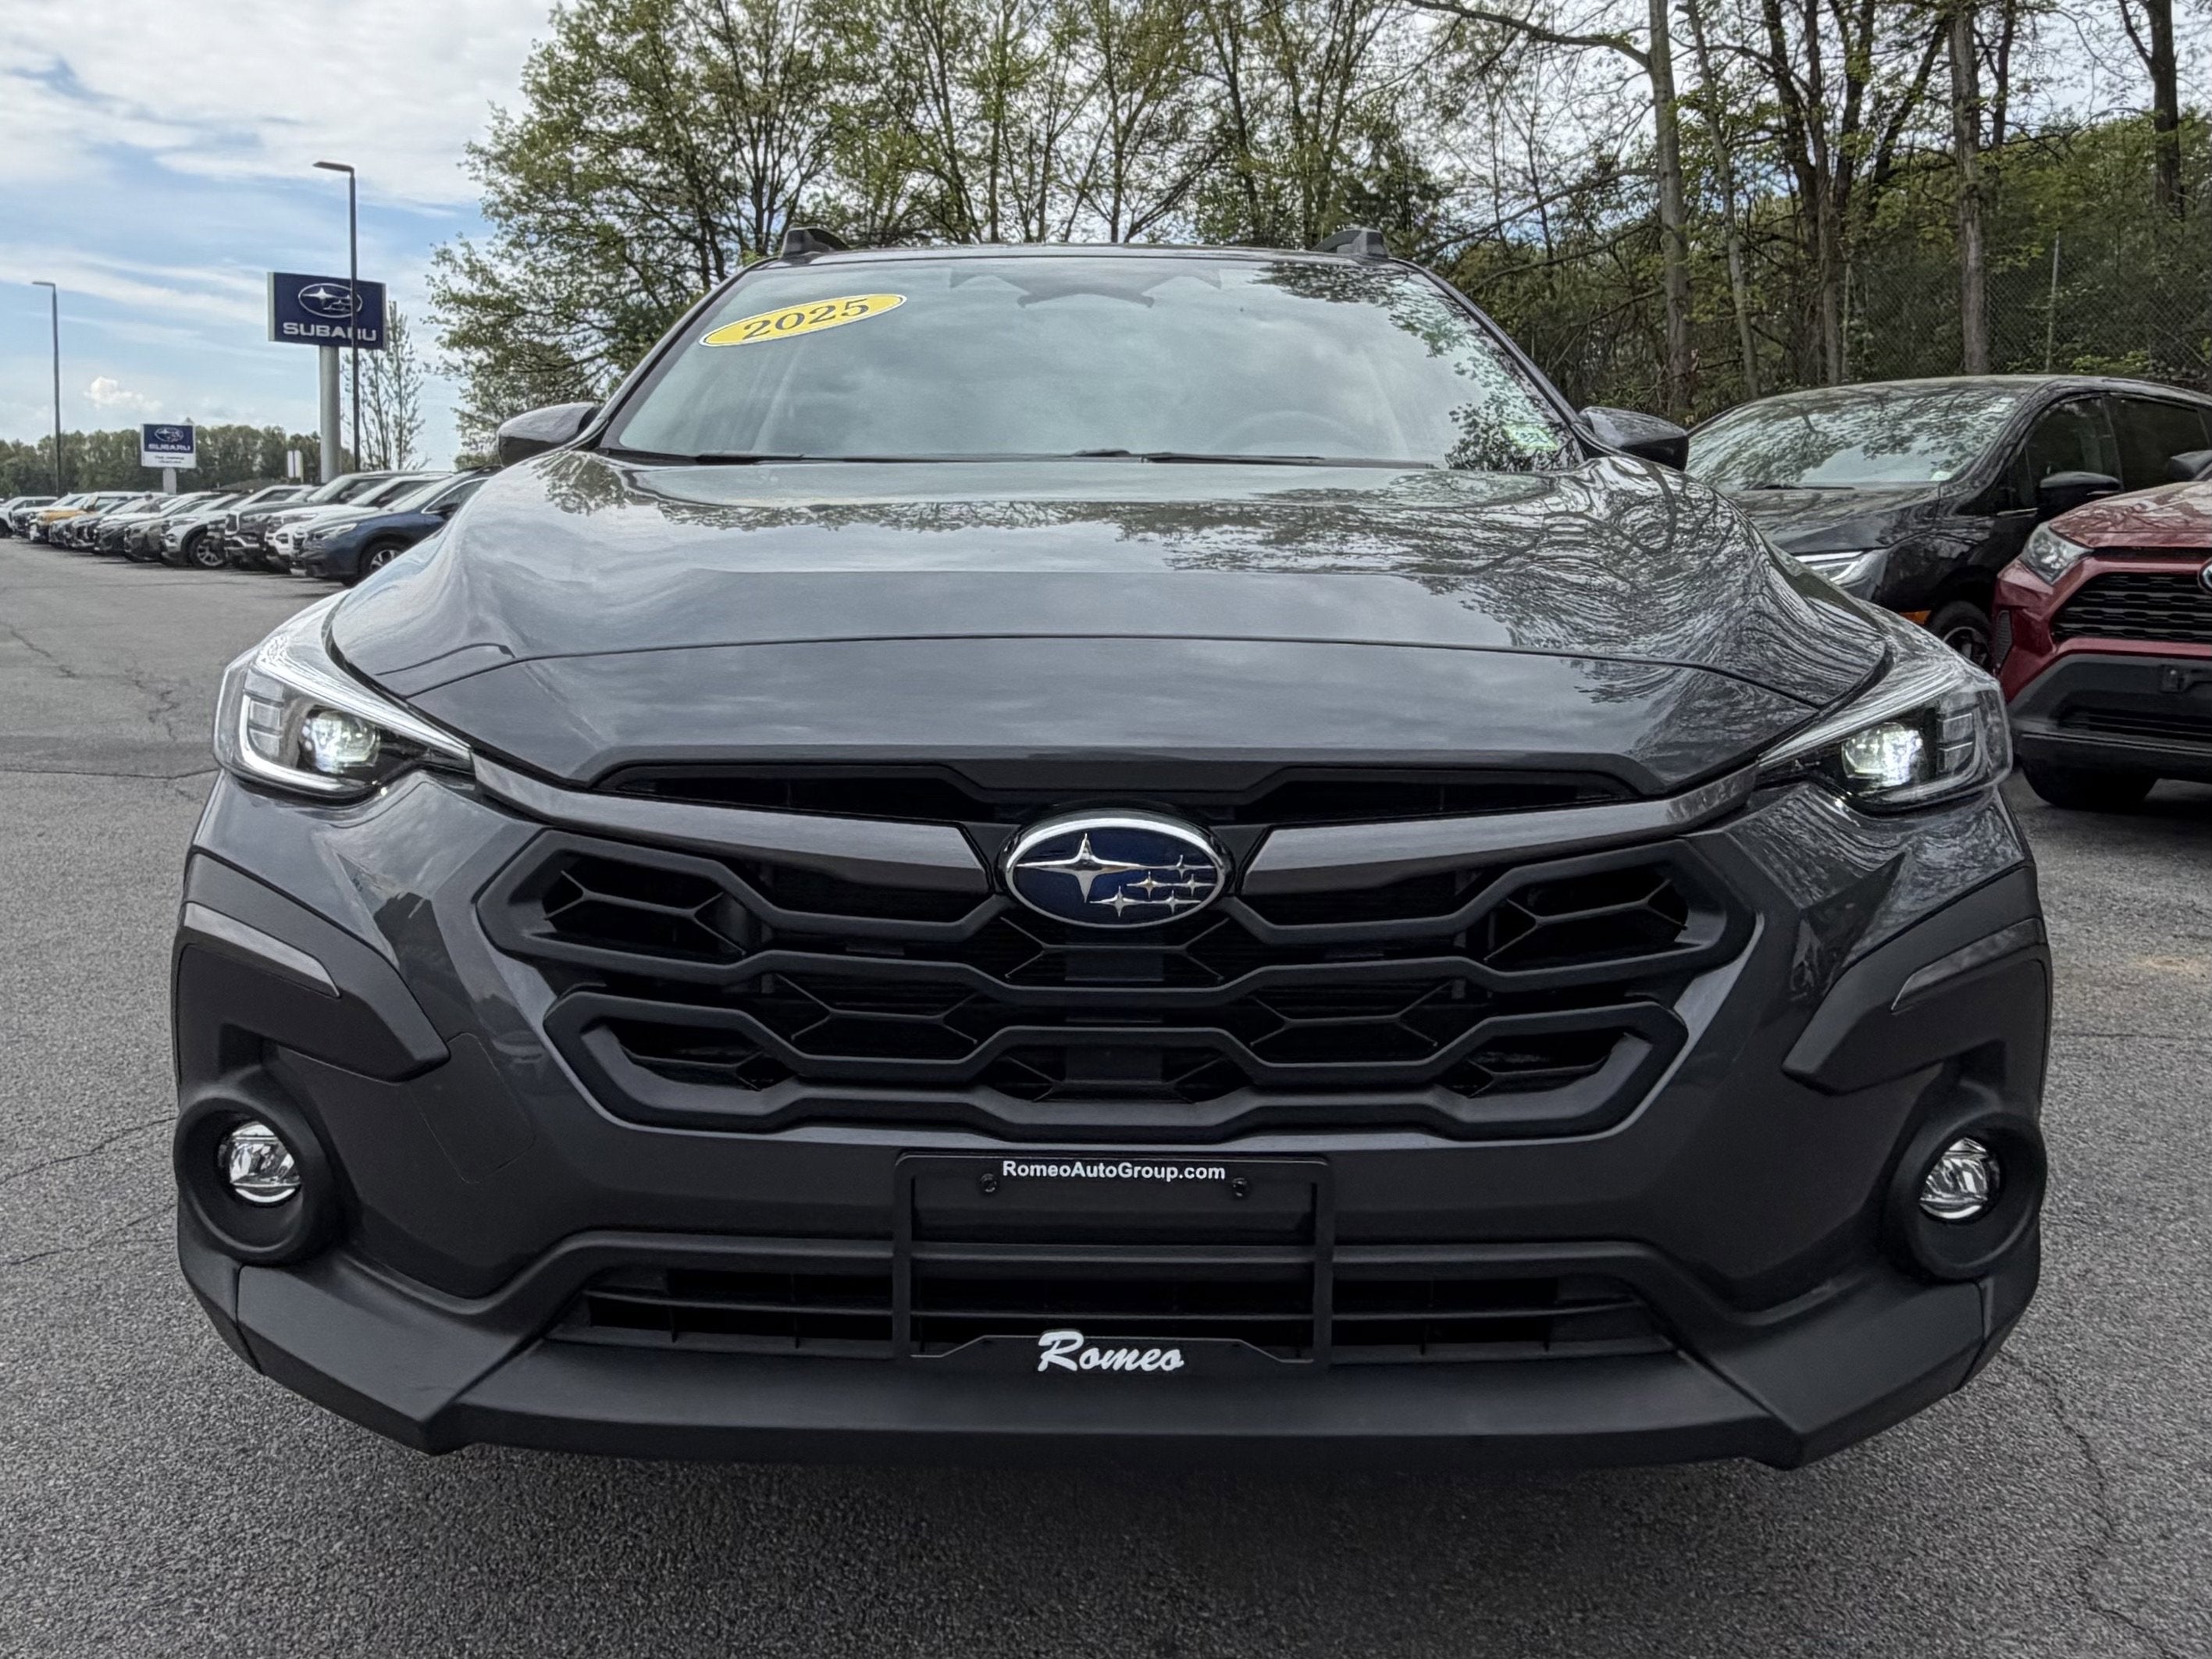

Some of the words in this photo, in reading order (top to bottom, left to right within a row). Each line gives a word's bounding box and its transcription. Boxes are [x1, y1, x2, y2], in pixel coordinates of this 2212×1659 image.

[742, 297, 870, 340] 2025
[1003, 1160, 1226, 1183] RomeoAutoGroup.com
[1038, 1330, 1185, 1372] Romeo
